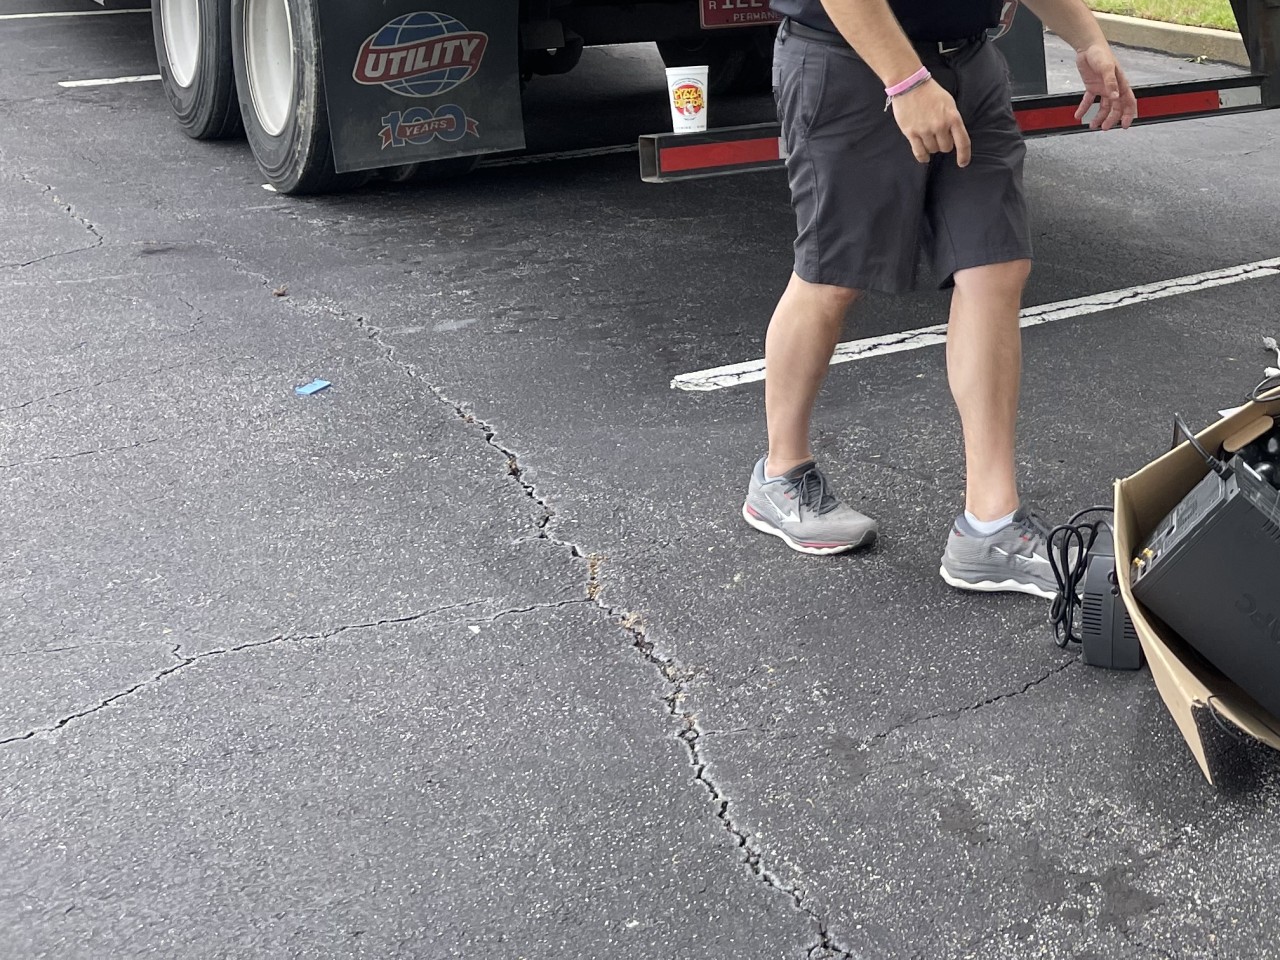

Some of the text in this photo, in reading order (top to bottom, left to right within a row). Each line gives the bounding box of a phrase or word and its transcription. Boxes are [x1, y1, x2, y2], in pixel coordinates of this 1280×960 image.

[364, 38, 480, 78] UTILITY
[673, 87, 703, 100] PIZZA
[381, 103, 467, 147] 100
[405, 120, 448, 136] YEARS
